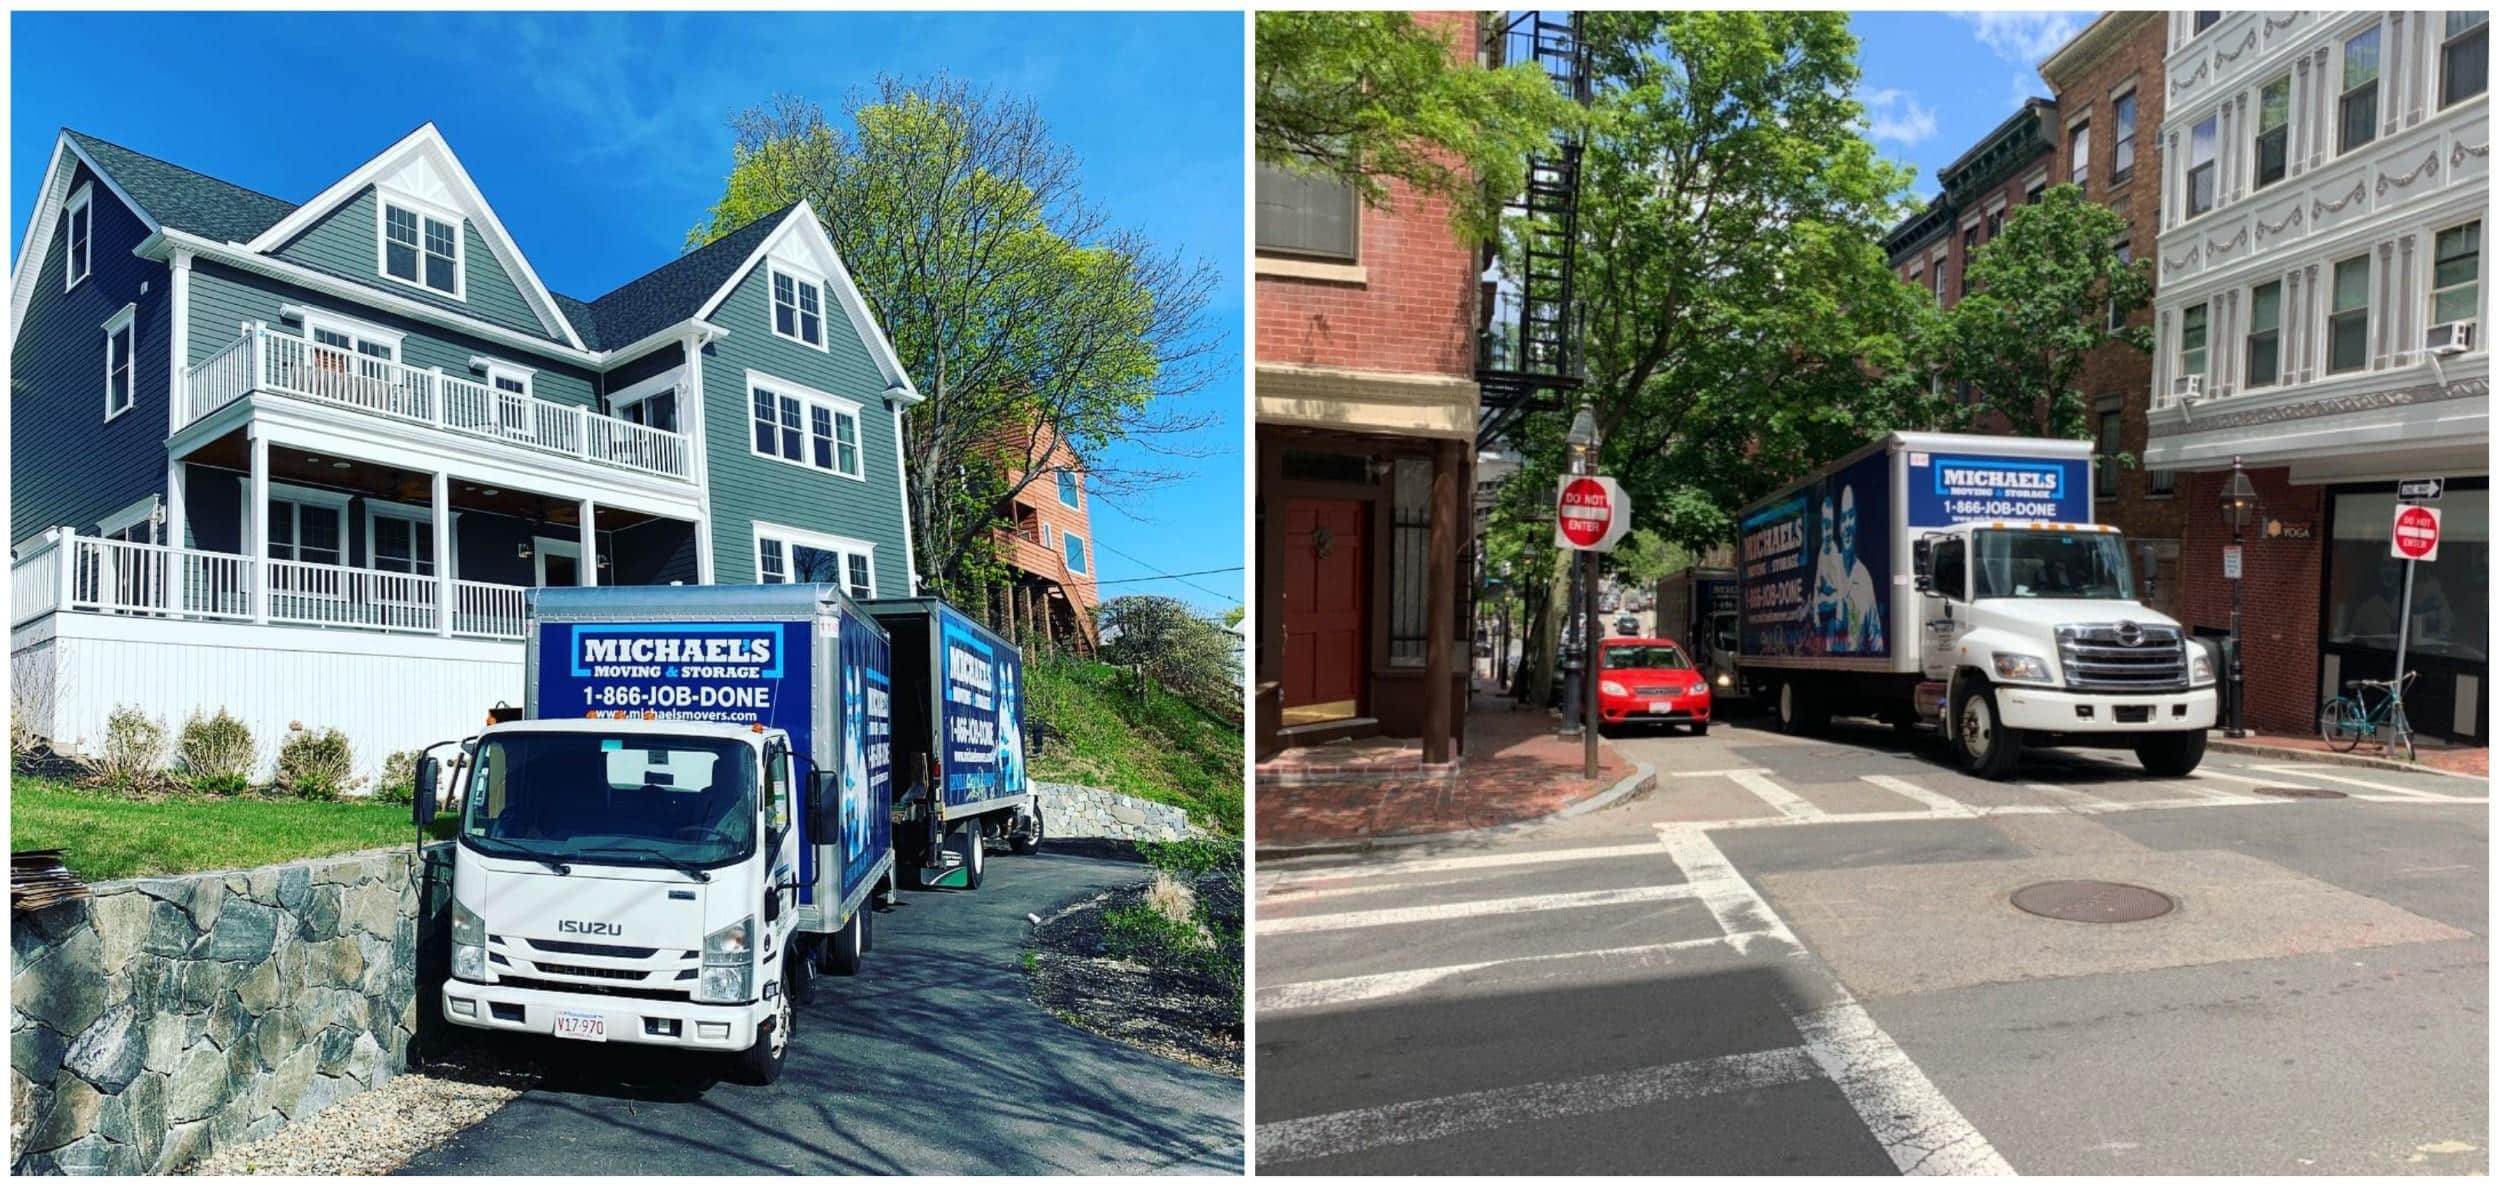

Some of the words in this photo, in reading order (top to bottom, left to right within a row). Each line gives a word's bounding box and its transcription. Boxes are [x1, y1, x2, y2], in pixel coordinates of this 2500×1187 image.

[1566, 492, 1580, 503] DO
[1584, 494, 1604, 506] NOT
[1950, 487, 1993, 496] MOVING
[2004, 488, 2050, 499] STORAGE
[1944, 500, 2057, 517] 1-866-JOB-DONE
[1568, 519, 1600, 532] ENTER
[2283, 527, 2311, 538] YOGA
[593, 665, 662, 678] MOVING
[665, 666, 679, 678] &
[681, 666, 760, 679] STORAGE
[583, 686, 770, 708] 1-866-JOB-DONE
[595, 708, 757, 722] ww.mihaelsmovers.com
[558, 919, 622, 936] ISUZU
